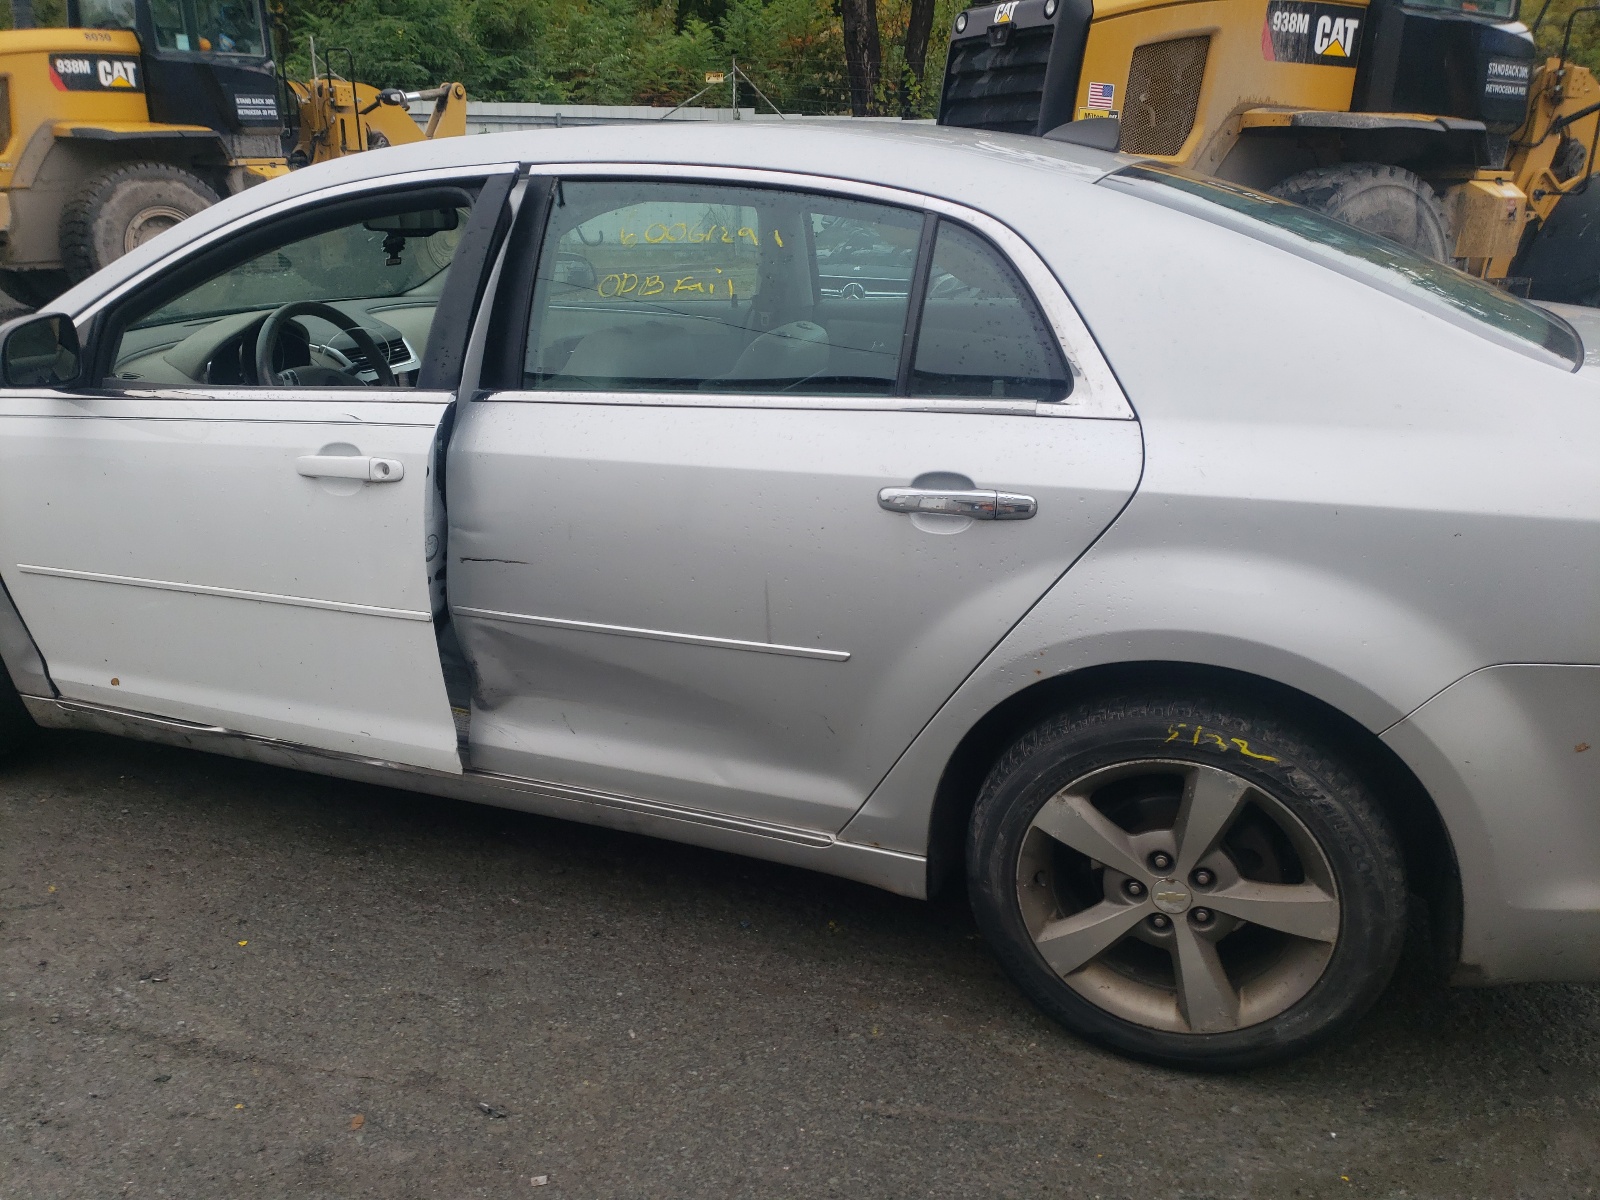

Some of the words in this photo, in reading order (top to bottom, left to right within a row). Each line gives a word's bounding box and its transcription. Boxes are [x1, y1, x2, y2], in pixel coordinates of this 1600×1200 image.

[993, 1, 1020, 23] CAT
[1272, 10, 1310, 34] 938M
[1314, 15, 1359, 57] CAT
[56, 59, 91, 74] 938M
[98, 60, 136, 88] CAT
